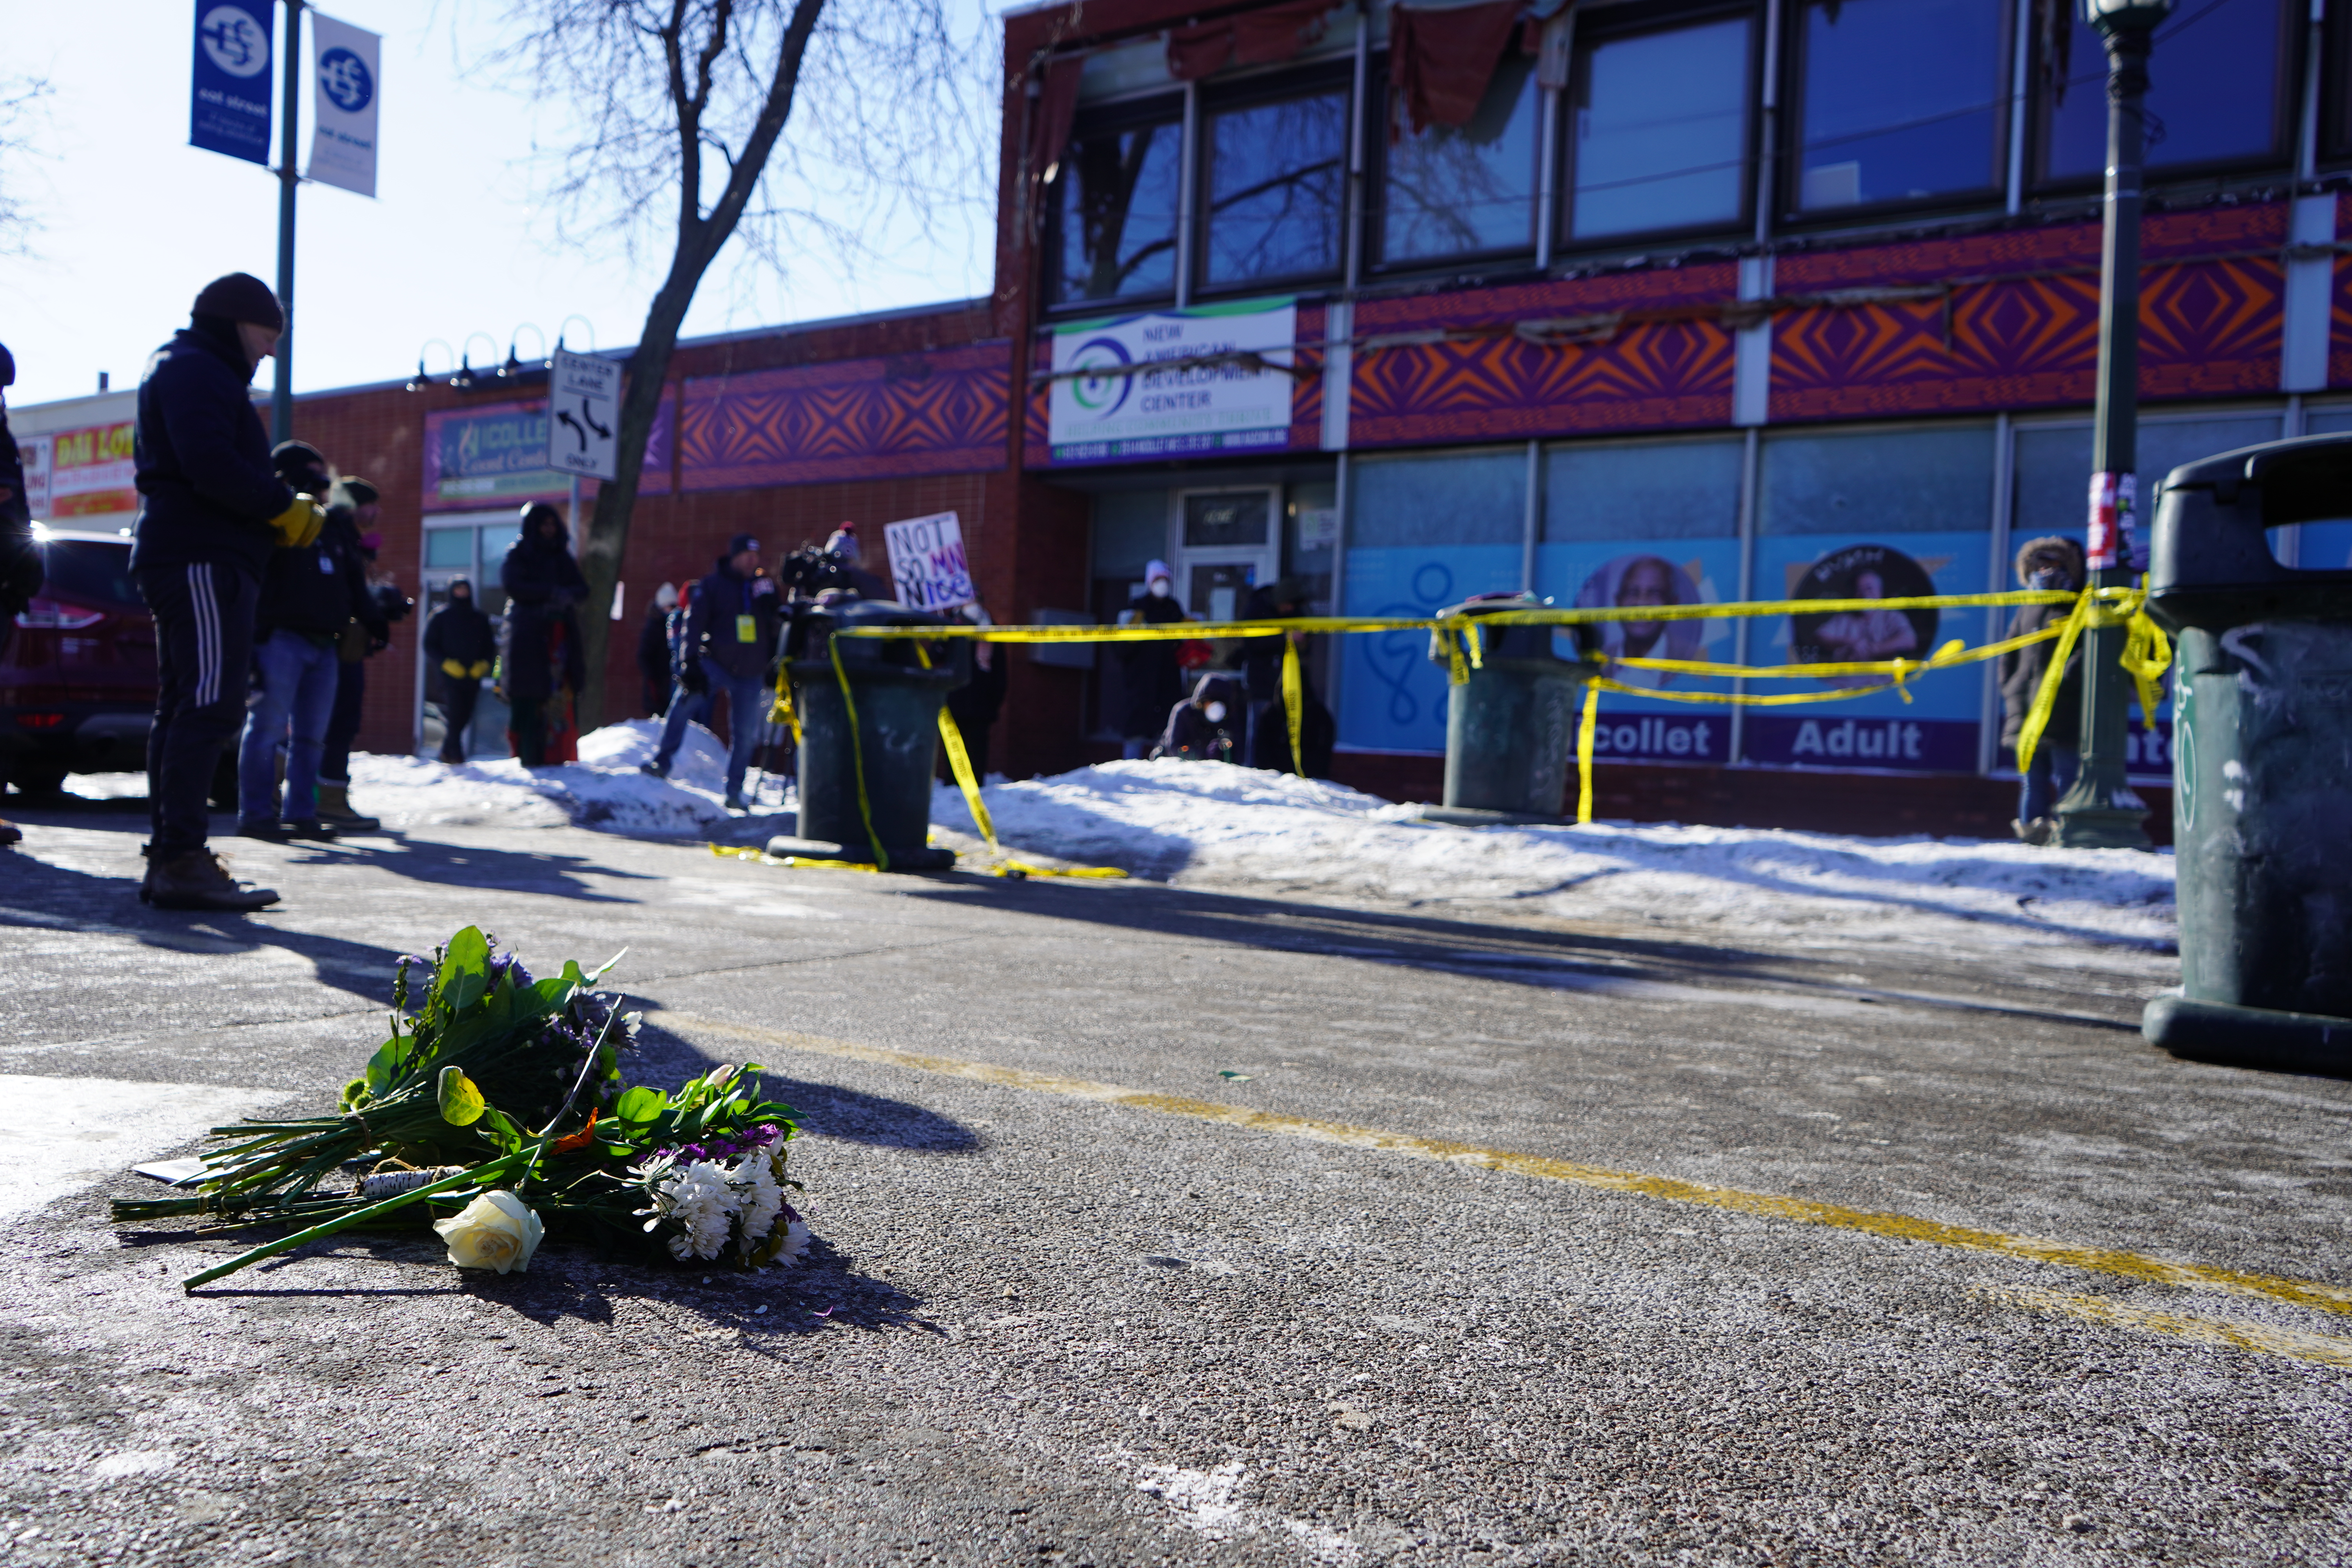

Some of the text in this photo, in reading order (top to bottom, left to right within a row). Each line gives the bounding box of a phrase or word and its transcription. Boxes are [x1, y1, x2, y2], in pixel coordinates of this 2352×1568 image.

[1143, 323, 1185, 343] NEW
[561, 356, 614, 378] CENTER
[567, 373, 604, 392] LANE
[1140, 389, 1213, 413] CENTER
[459, 419, 546, 457] NICOLLE
[891, 515, 952, 556] NOT
[896, 557, 926, 584] SO
[1792, 720, 1923, 759] Adult
